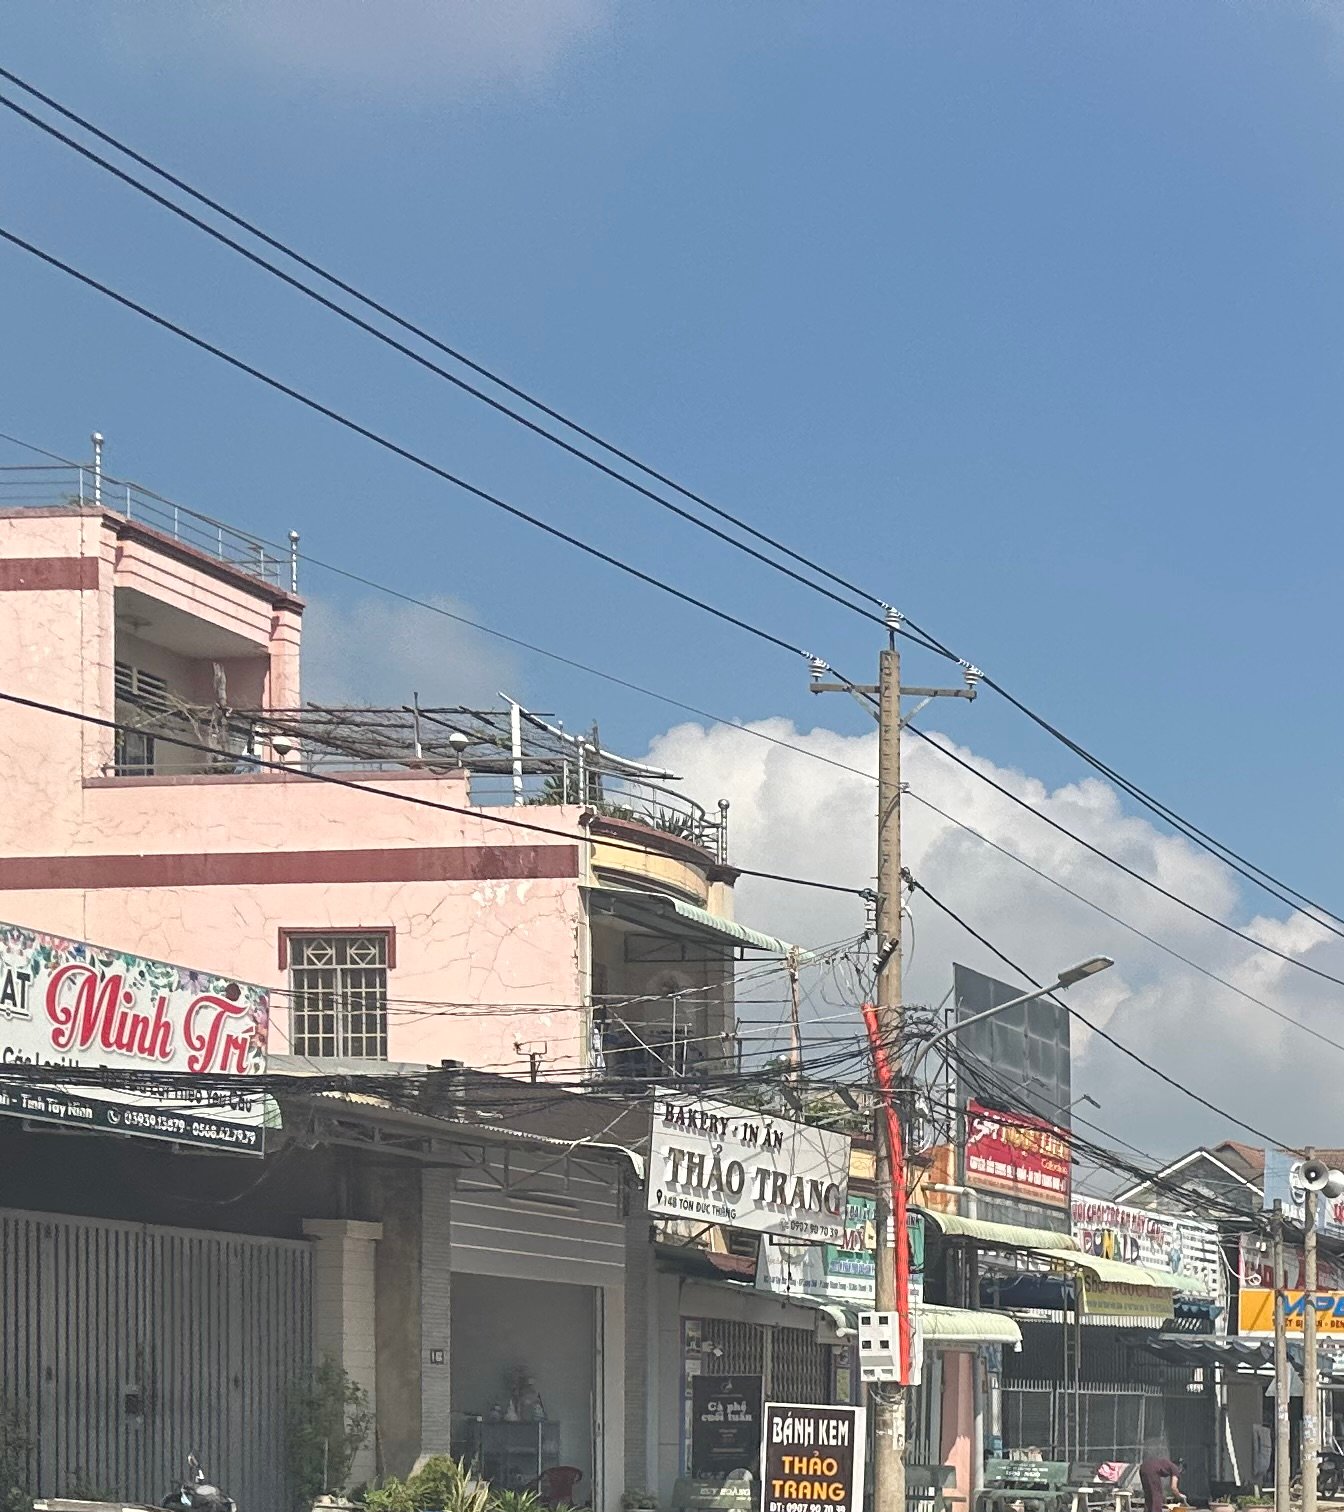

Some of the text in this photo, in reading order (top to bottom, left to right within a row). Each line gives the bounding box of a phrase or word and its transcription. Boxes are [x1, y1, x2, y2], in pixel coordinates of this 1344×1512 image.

[46, 964, 255, 1074] Minh Trí
[665, 1102, 730, 1136] BAKERY
[742, 1122, 759, 1143] IN
[667, 1144, 745, 1195] THẢO
[754, 1167, 841, 1217] TRANG
[772, 1412, 814, 1447] BÁNH
[818, 1419, 849, 1446] KEM
[782, 1450, 838, 1476] THẢO
[772, 1480, 846, 1501] TRANG
